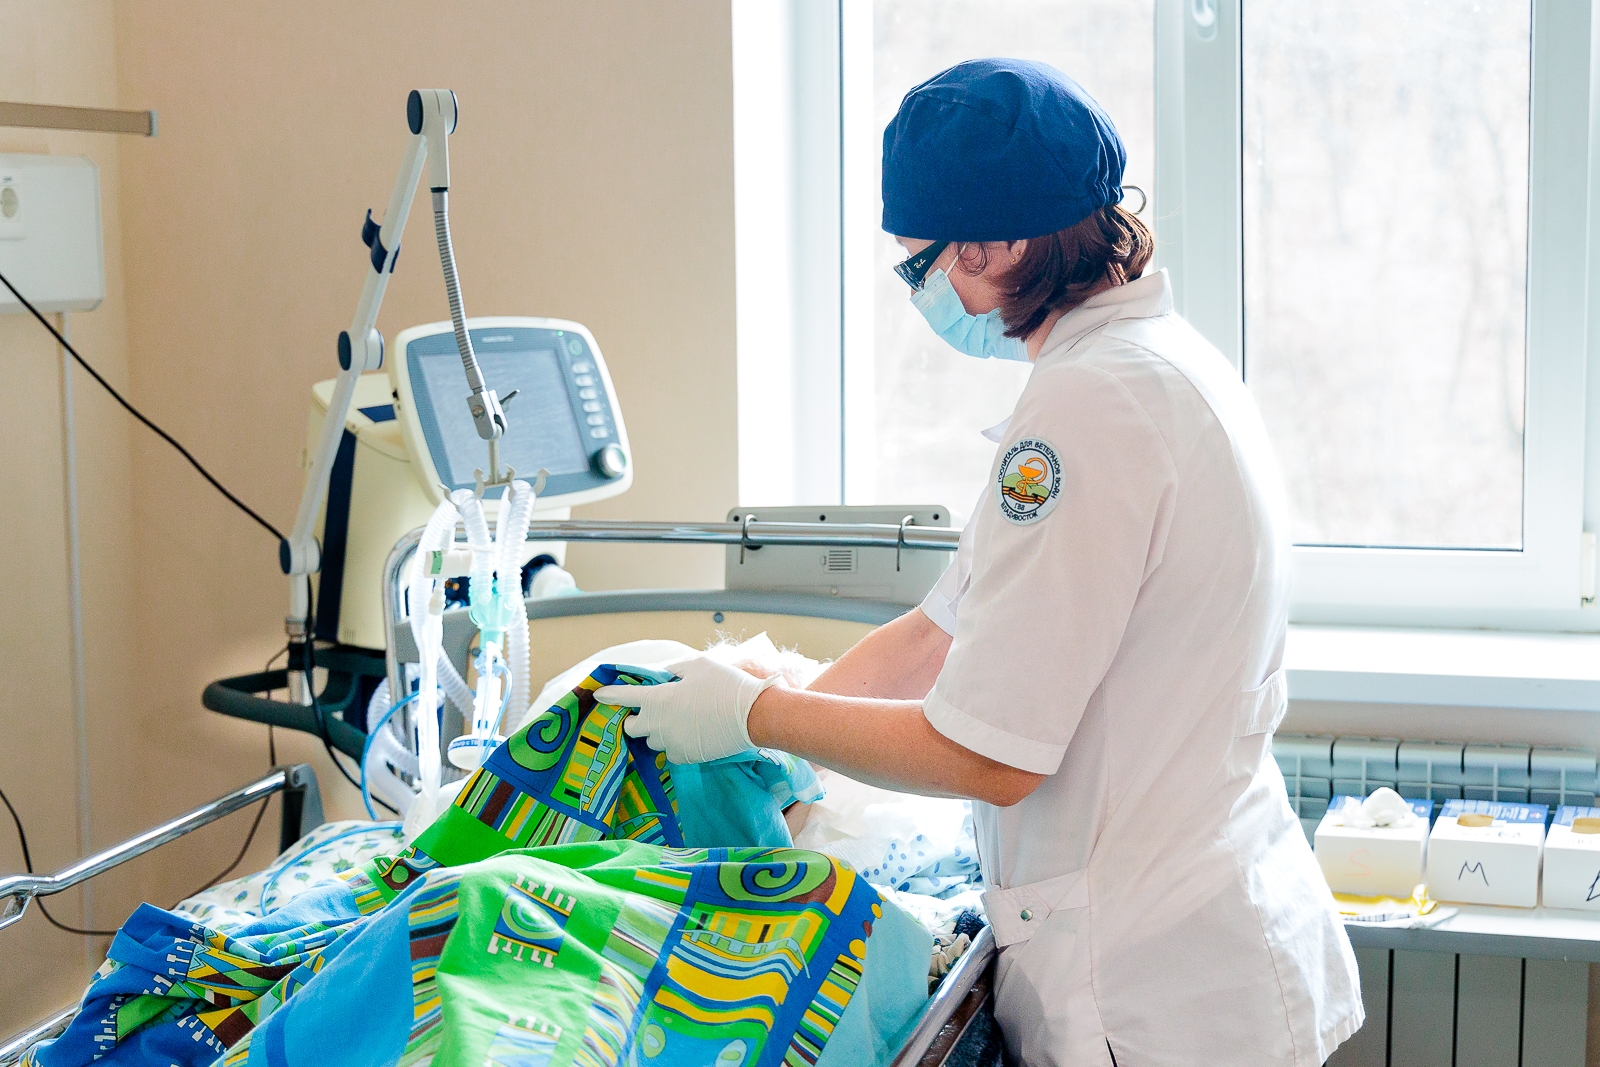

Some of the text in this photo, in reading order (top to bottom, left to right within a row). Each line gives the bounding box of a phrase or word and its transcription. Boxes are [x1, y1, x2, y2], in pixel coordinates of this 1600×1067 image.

[998, 446, 1019, 483] ГОСПИТАЛЬ
[1019, 440, 1033, 450] ДЛЯ
[1034, 441, 1061, 475] ВЕТЕРАНОВ
[1000, 501, 1038, 521] ВЛАДИВОСТОК
[1458, 860, 1489, 887] M
